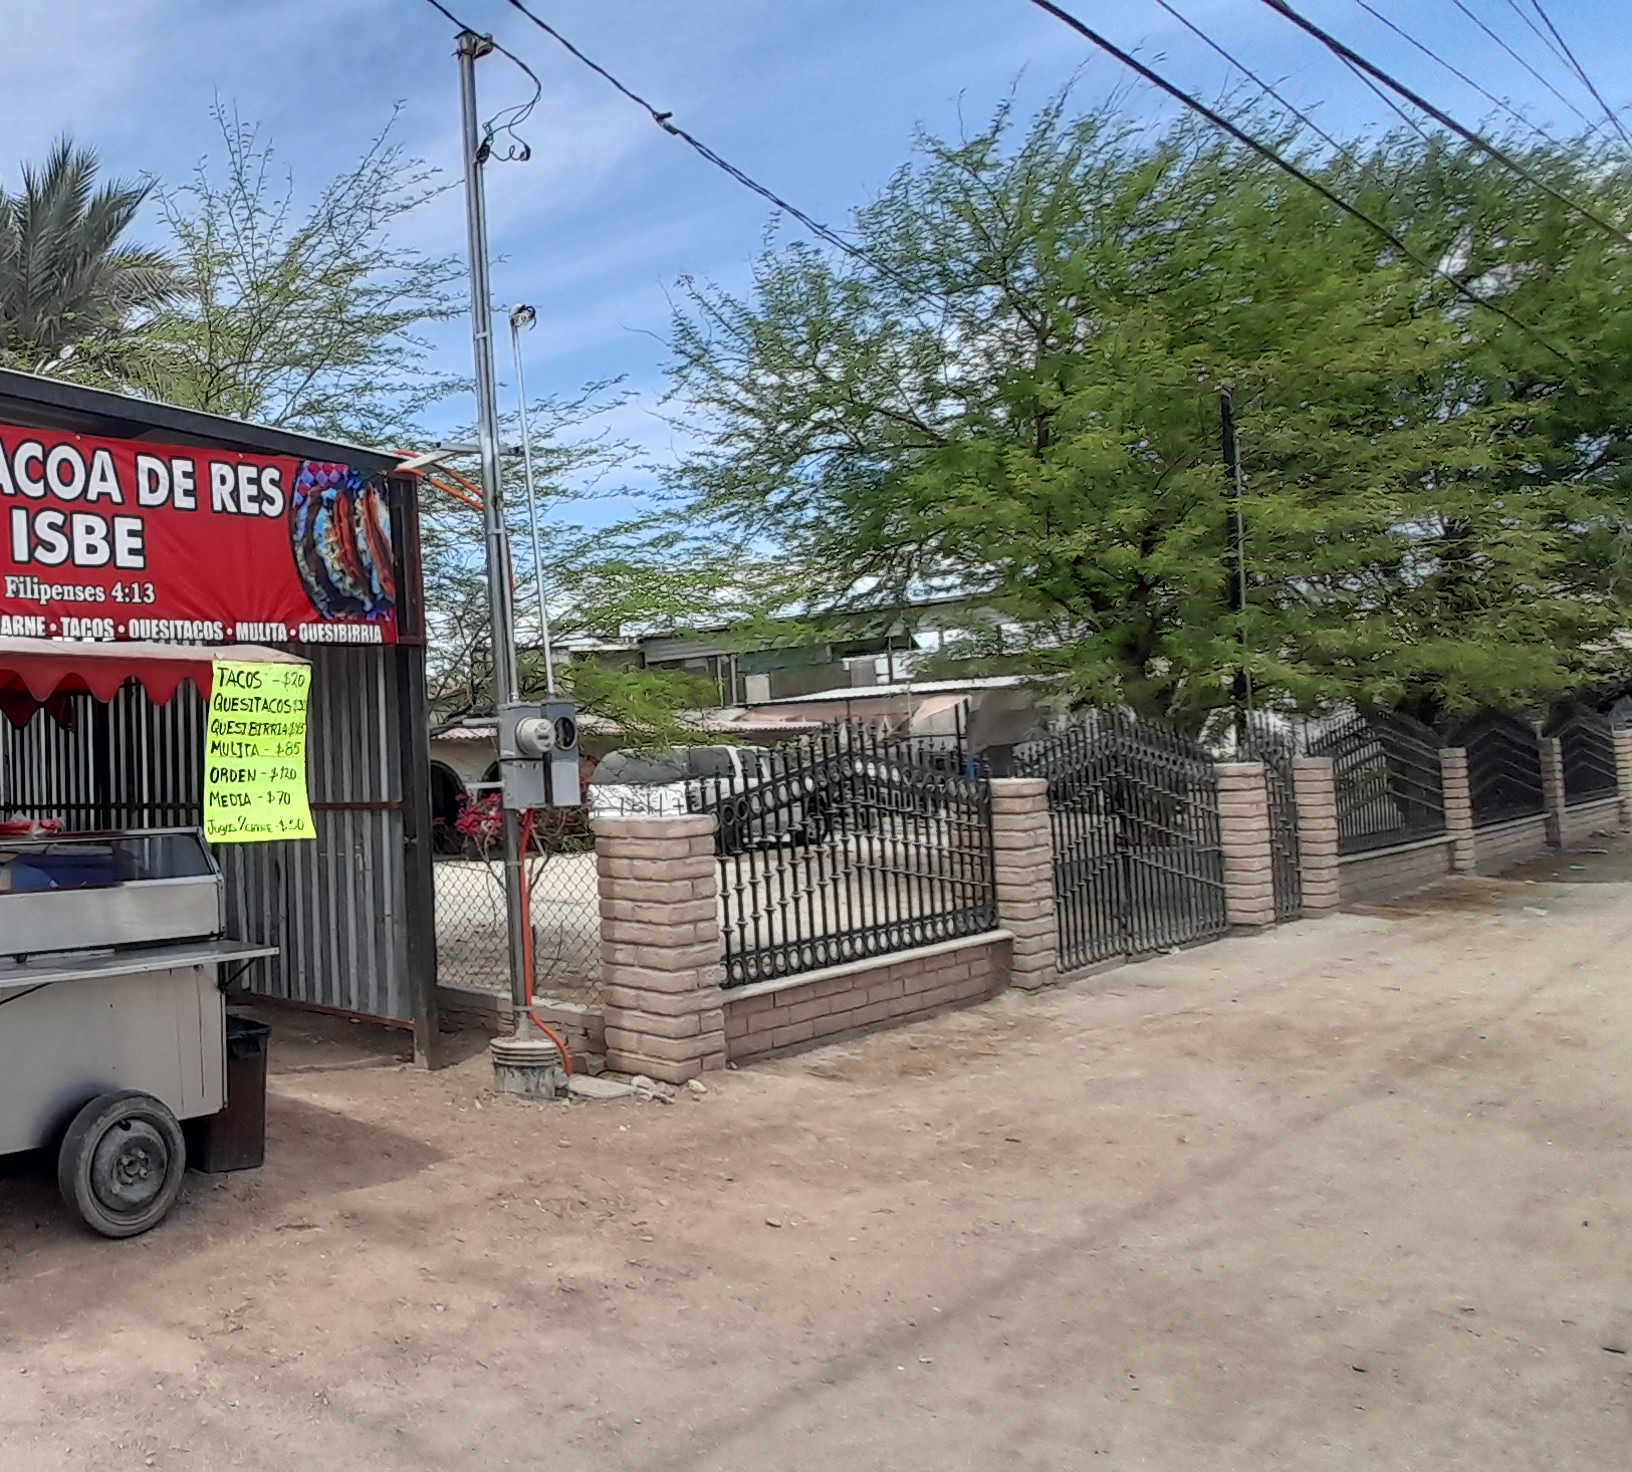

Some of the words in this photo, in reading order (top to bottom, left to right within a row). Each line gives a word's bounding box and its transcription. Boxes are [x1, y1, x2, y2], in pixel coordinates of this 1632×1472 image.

[135, 454, 198, 511] DE
[209, 461, 285, 518] RES
[10, 504, 146, 571] ISBE
[3, 574, 106, 605] Filipenses
[111, 581, 156, 604] 4:13
[60, 616, 115, 639] TACOS
[128, 618, 224, 641] QUESITACOS
[236, 621, 288, 643] MULITA
[298, 623, 383, 644] QUESIBIRRIA
[217, 666, 263, 690] TACOS
[213, 692, 292, 714] QUESITACOS
[210, 718, 288, 737] QUESIBIRRIA
[210, 740, 260, 759] MULITA
[276, 741, 302, 757] $85
[209, 766, 257, 784] ORDEN
[270, 766, 298, 783] $120
[209, 790, 252, 808] MEDIA
[266, 790, 291, 806] $70
